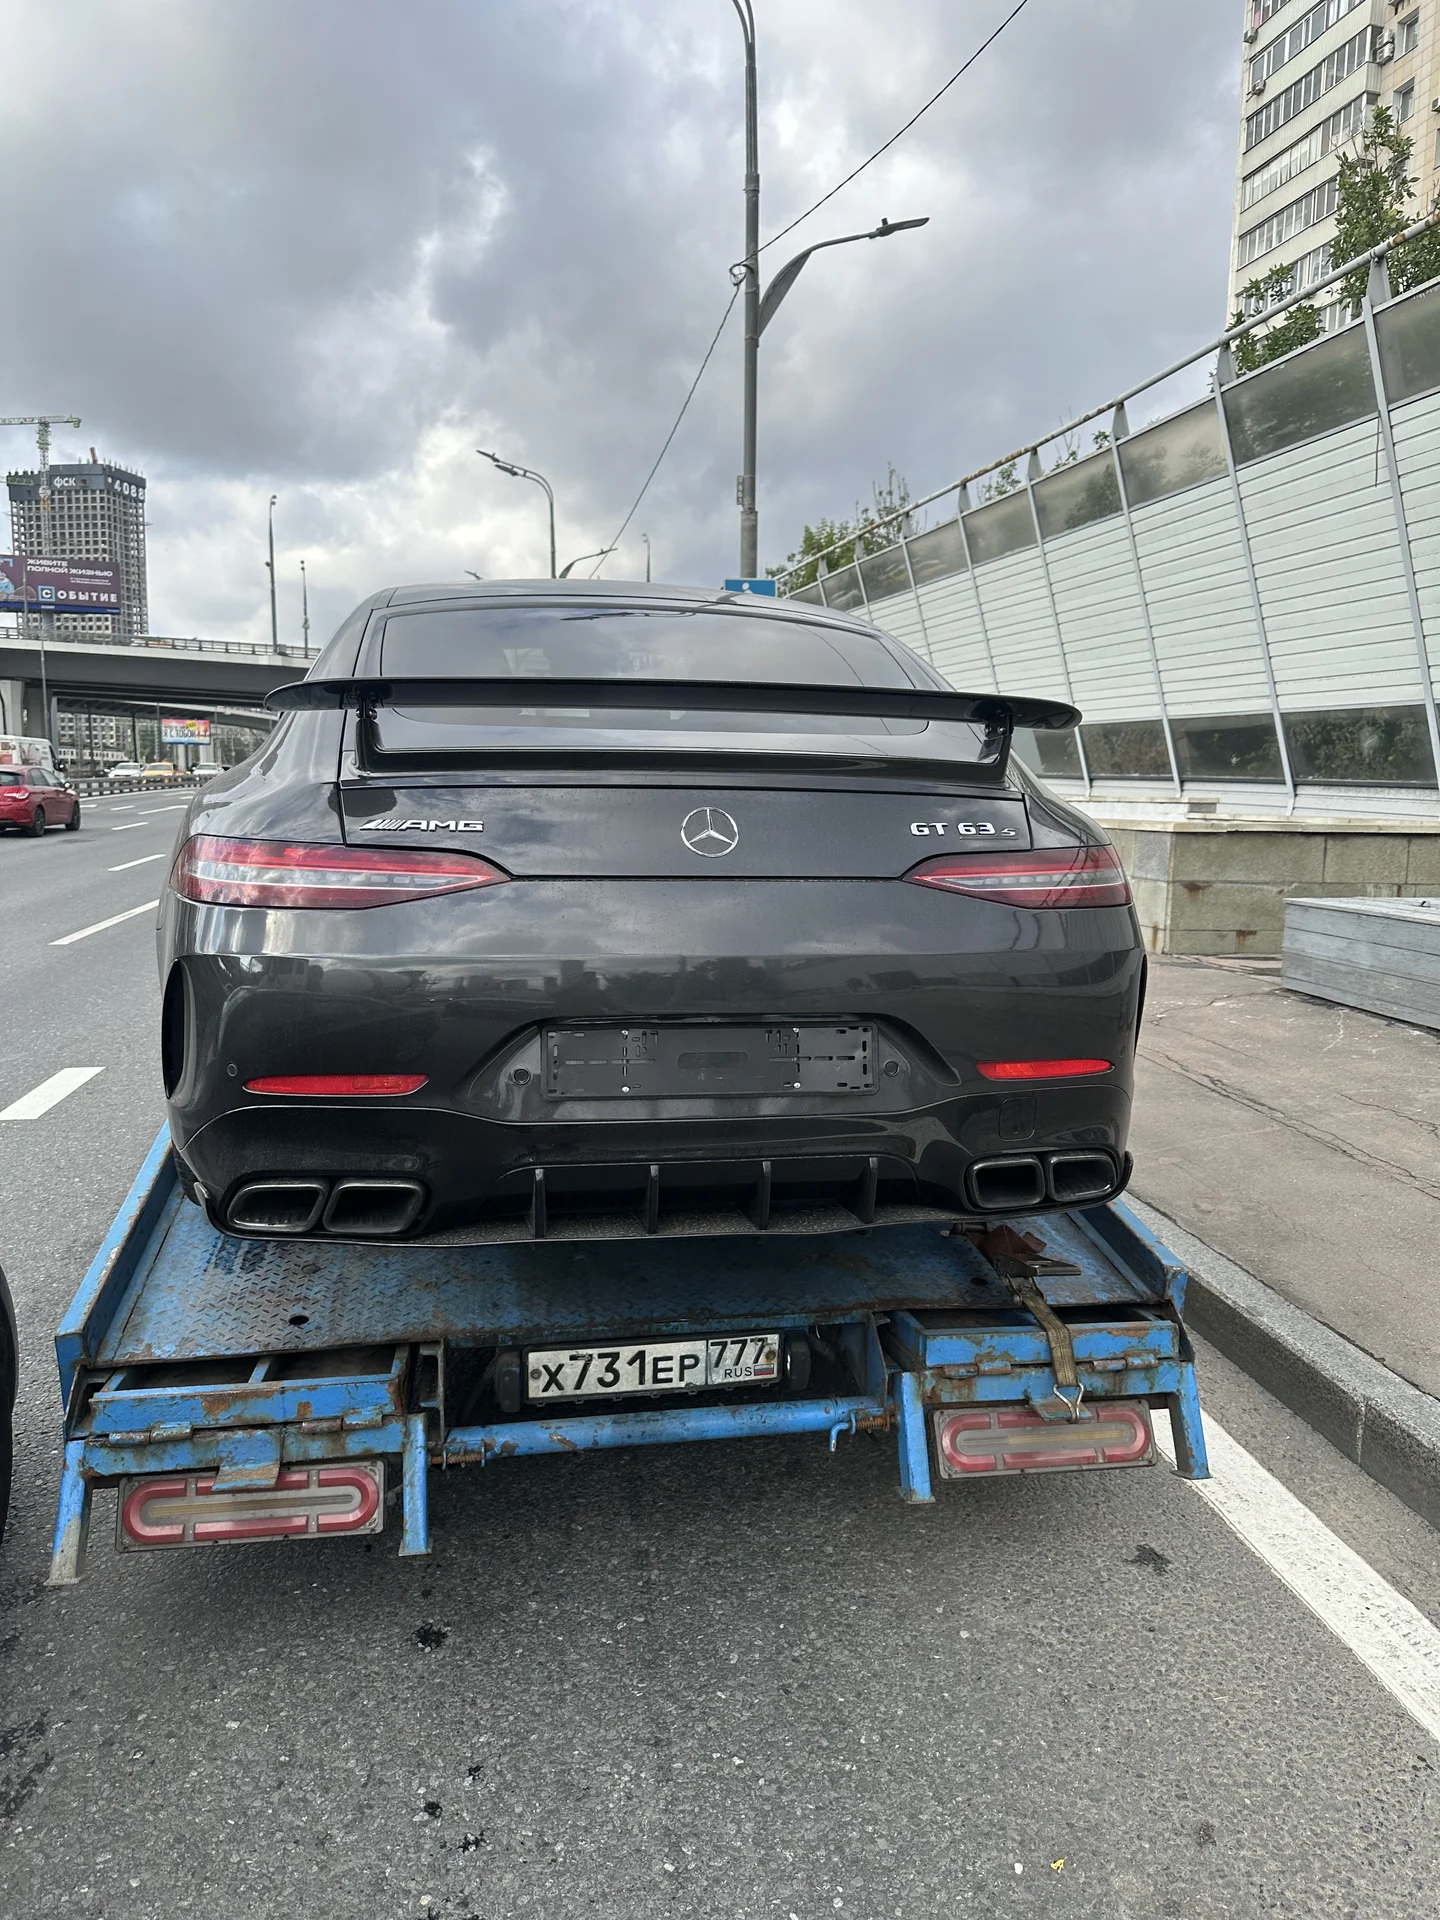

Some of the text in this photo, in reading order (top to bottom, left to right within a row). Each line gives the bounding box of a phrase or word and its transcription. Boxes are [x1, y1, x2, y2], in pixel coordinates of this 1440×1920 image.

[26, 558, 68, 566] ЖИВИТЕ
[26, 565, 114, 577] ПОЛНОЙ ЖИЗНЬЮ
[910, 822, 948, 836] GT
[957, 822, 996, 836] 63
[709, 1337, 769, 1369] 777
[724, 1365, 753, 1379] RUS
